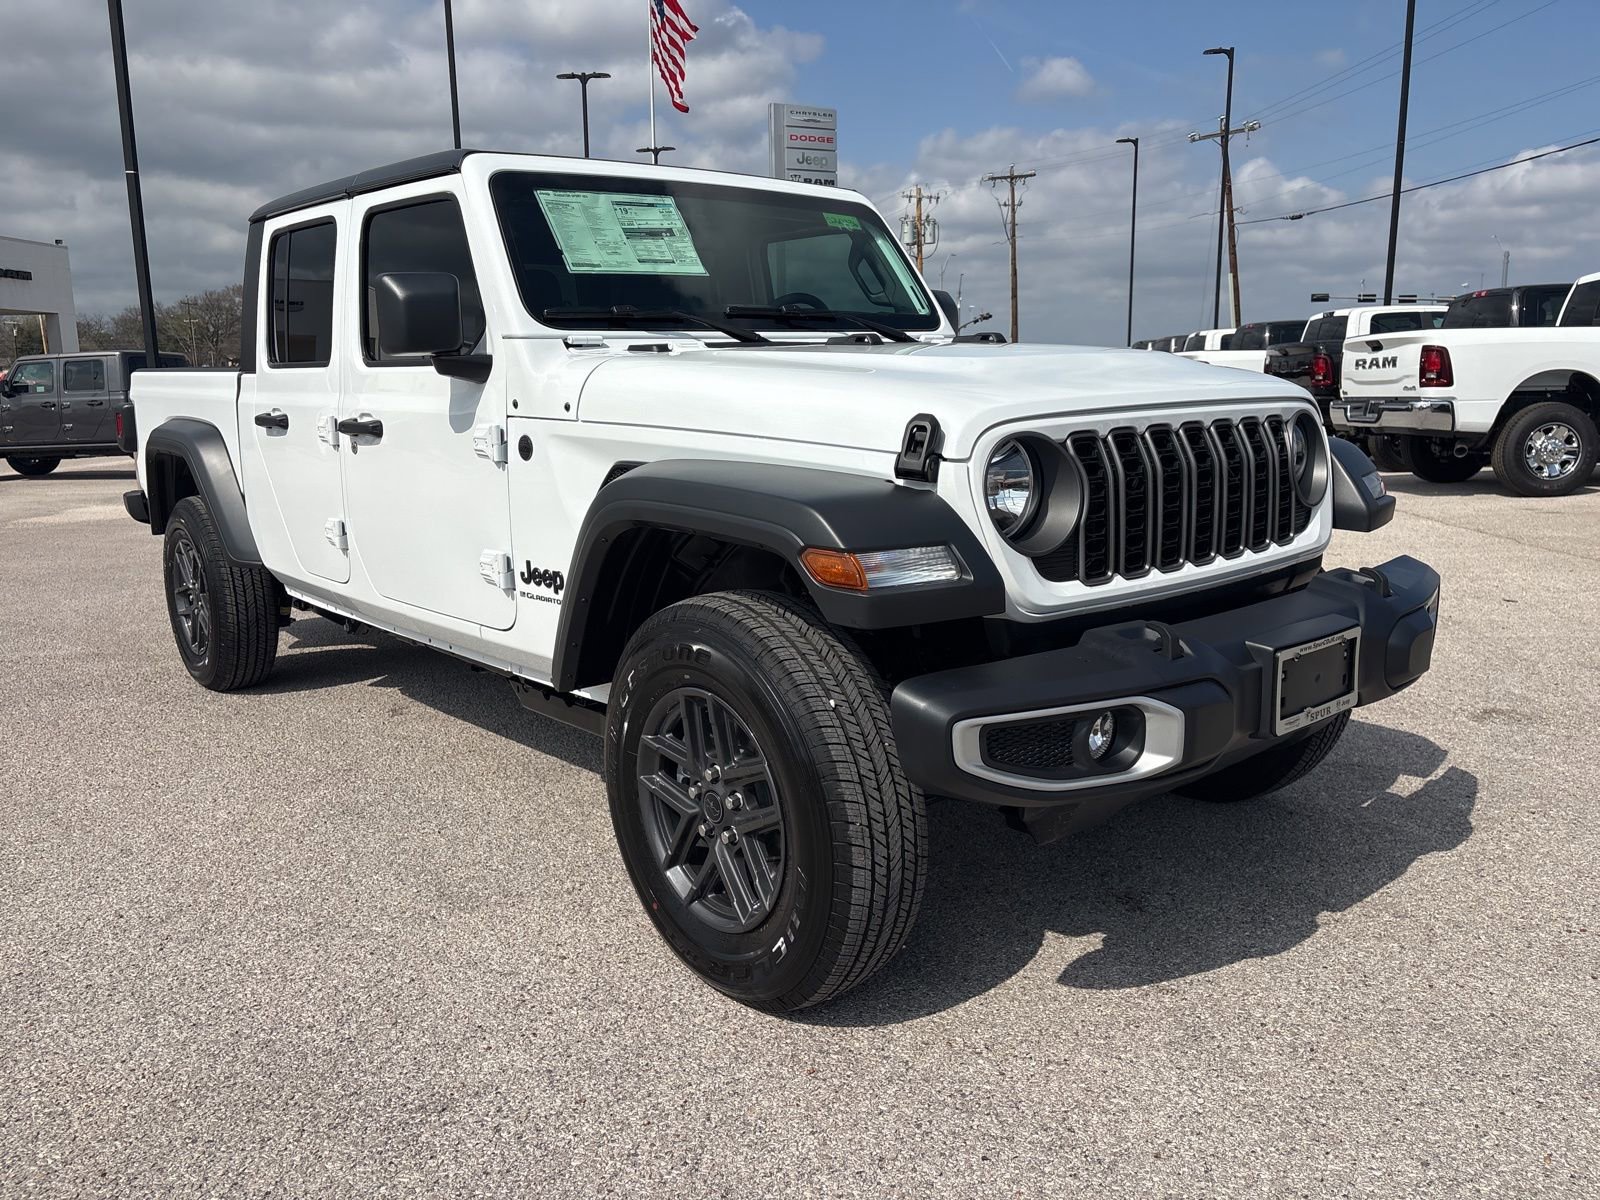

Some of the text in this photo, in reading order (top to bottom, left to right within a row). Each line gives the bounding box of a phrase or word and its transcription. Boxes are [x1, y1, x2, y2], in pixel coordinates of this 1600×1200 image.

[790, 110, 833, 118] CHRYSLER
[789, 134, 834, 144] DODGE
[796, 152, 828, 168] Jeep
[803, 177, 835, 186] RAM
[1354, 356, 1398, 370] RAM
[520, 559, 565, 596] Jeep
[526, 592, 562, 606] GLADIATO
[1310, 706, 1331, 720] SPUR
